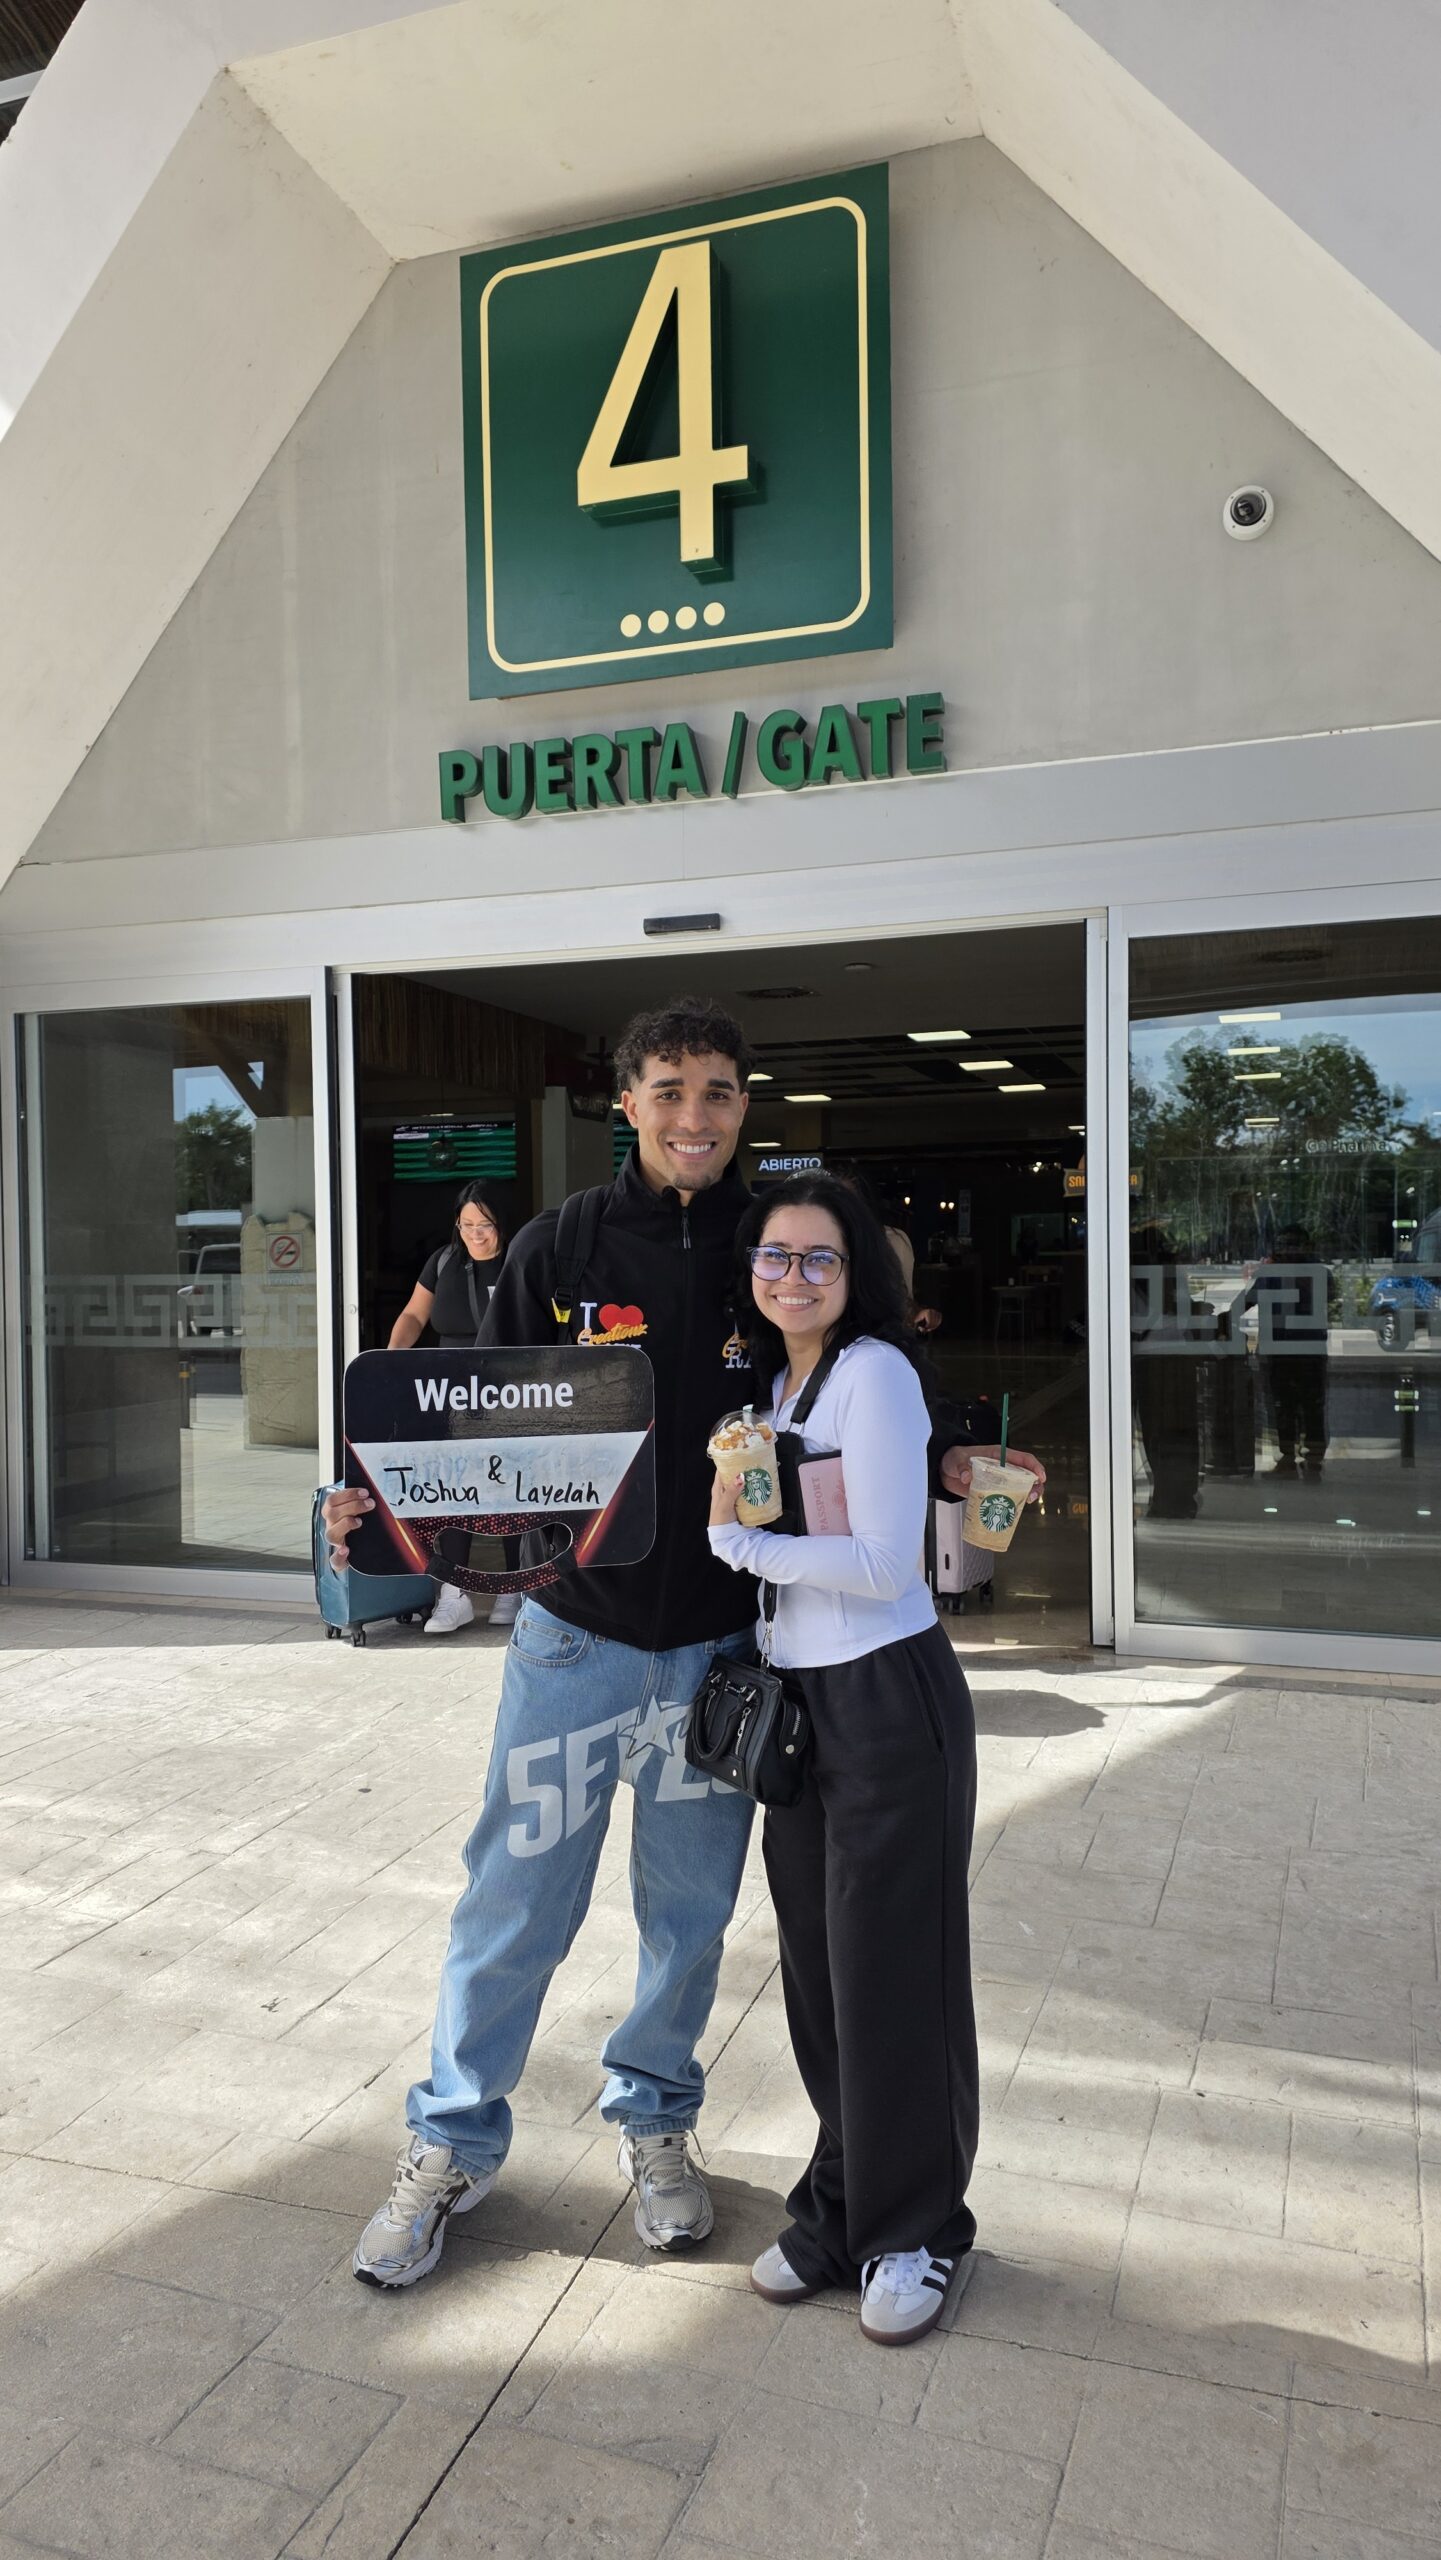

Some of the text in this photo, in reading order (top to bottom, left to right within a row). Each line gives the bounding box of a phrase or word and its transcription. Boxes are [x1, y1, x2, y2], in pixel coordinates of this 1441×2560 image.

[577, 240, 752, 564] 4
[438, 722, 708, 823] PUERTA
[758, 1157, 822, 1172] ABIERTO
[414, 1375, 574, 1412] Welcome
[384, 1454, 601, 1506] Joshua & Layelah
[811, 1475, 830, 1531] PASSPORT
